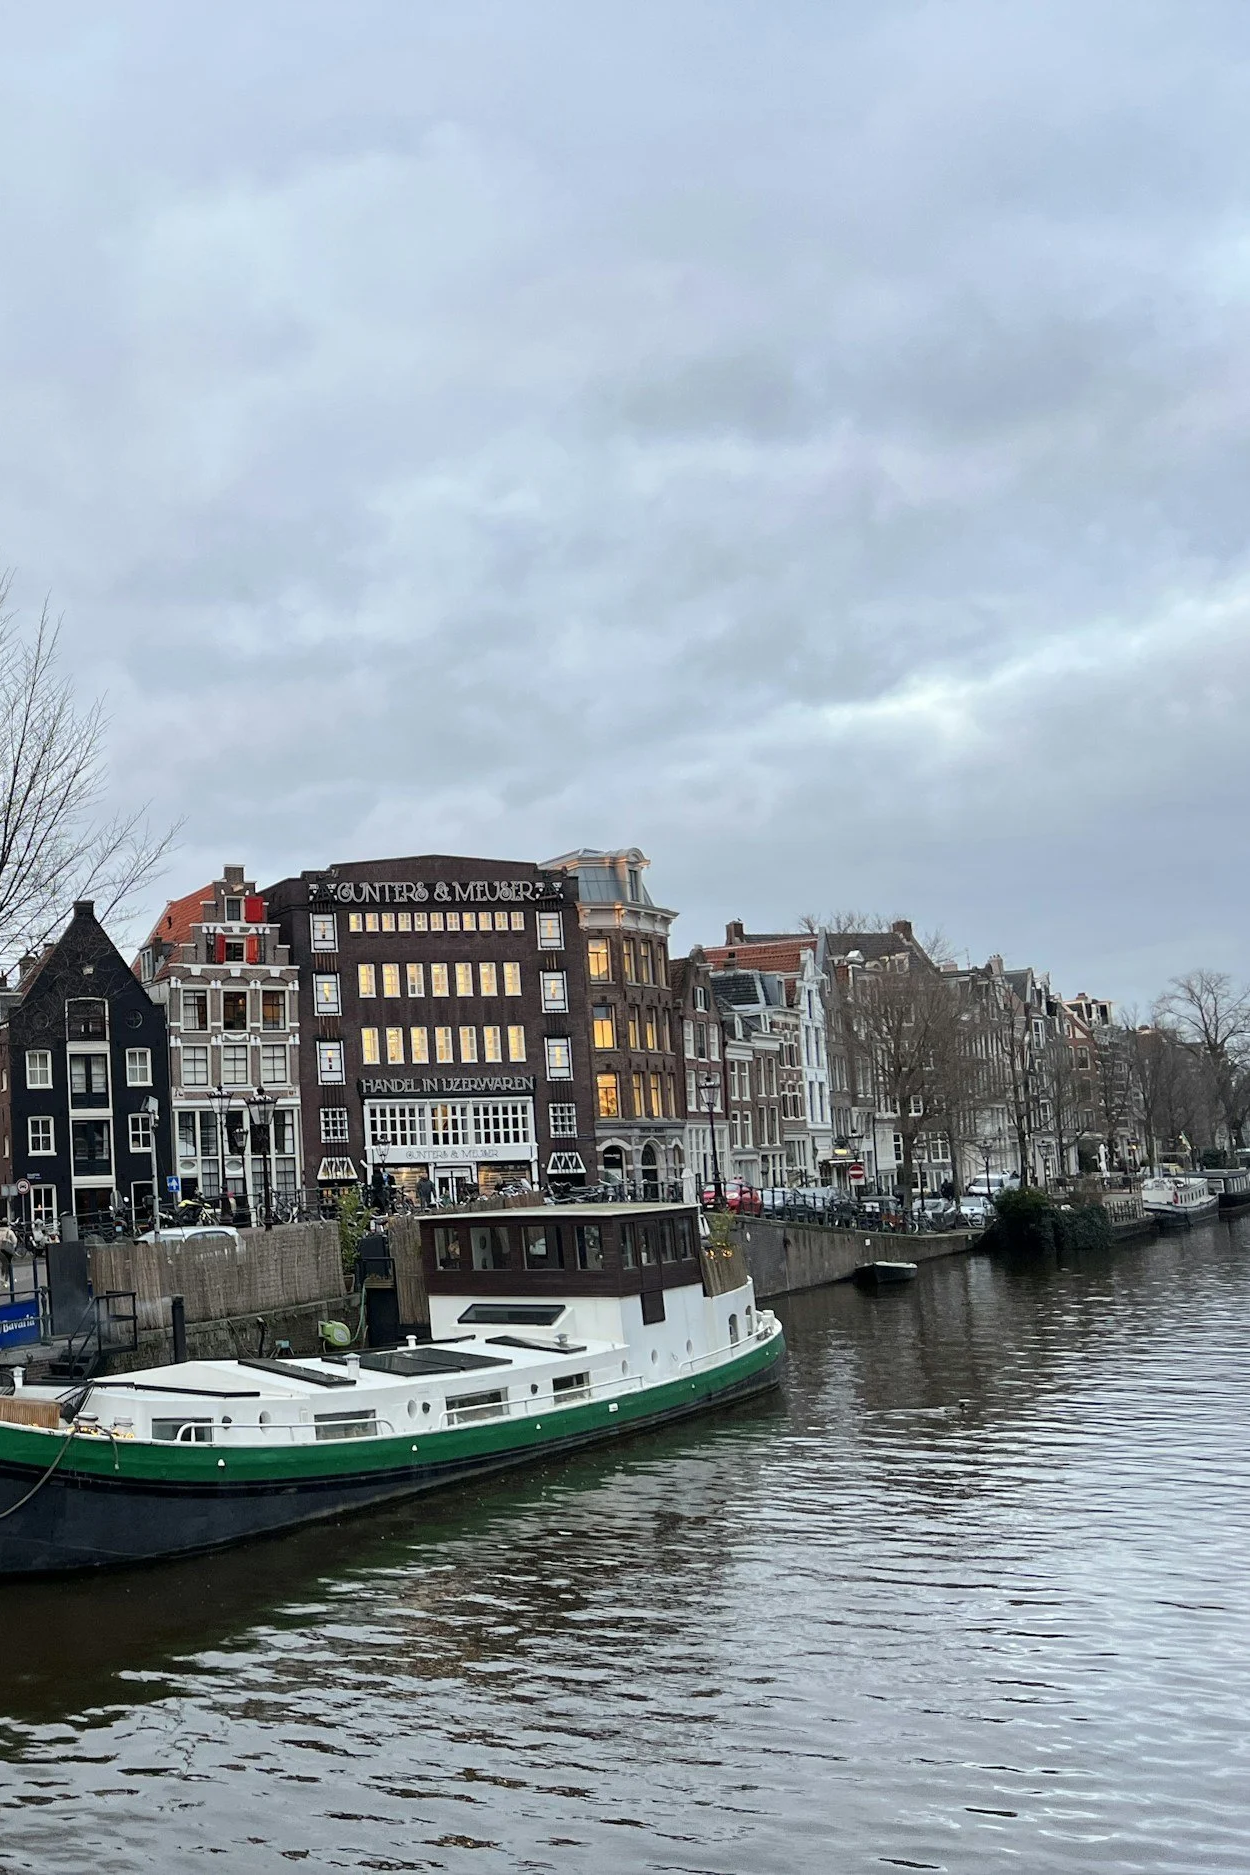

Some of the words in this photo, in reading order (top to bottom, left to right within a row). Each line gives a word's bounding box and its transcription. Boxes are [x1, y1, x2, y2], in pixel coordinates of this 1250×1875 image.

[337, 881, 429, 903] GUNTERS
[433, 881, 452, 902] &
[451, 880, 536, 902] MEUSER
[361, 1078, 420, 1093] HANDEL
[422, 1077, 438, 1092] IN
